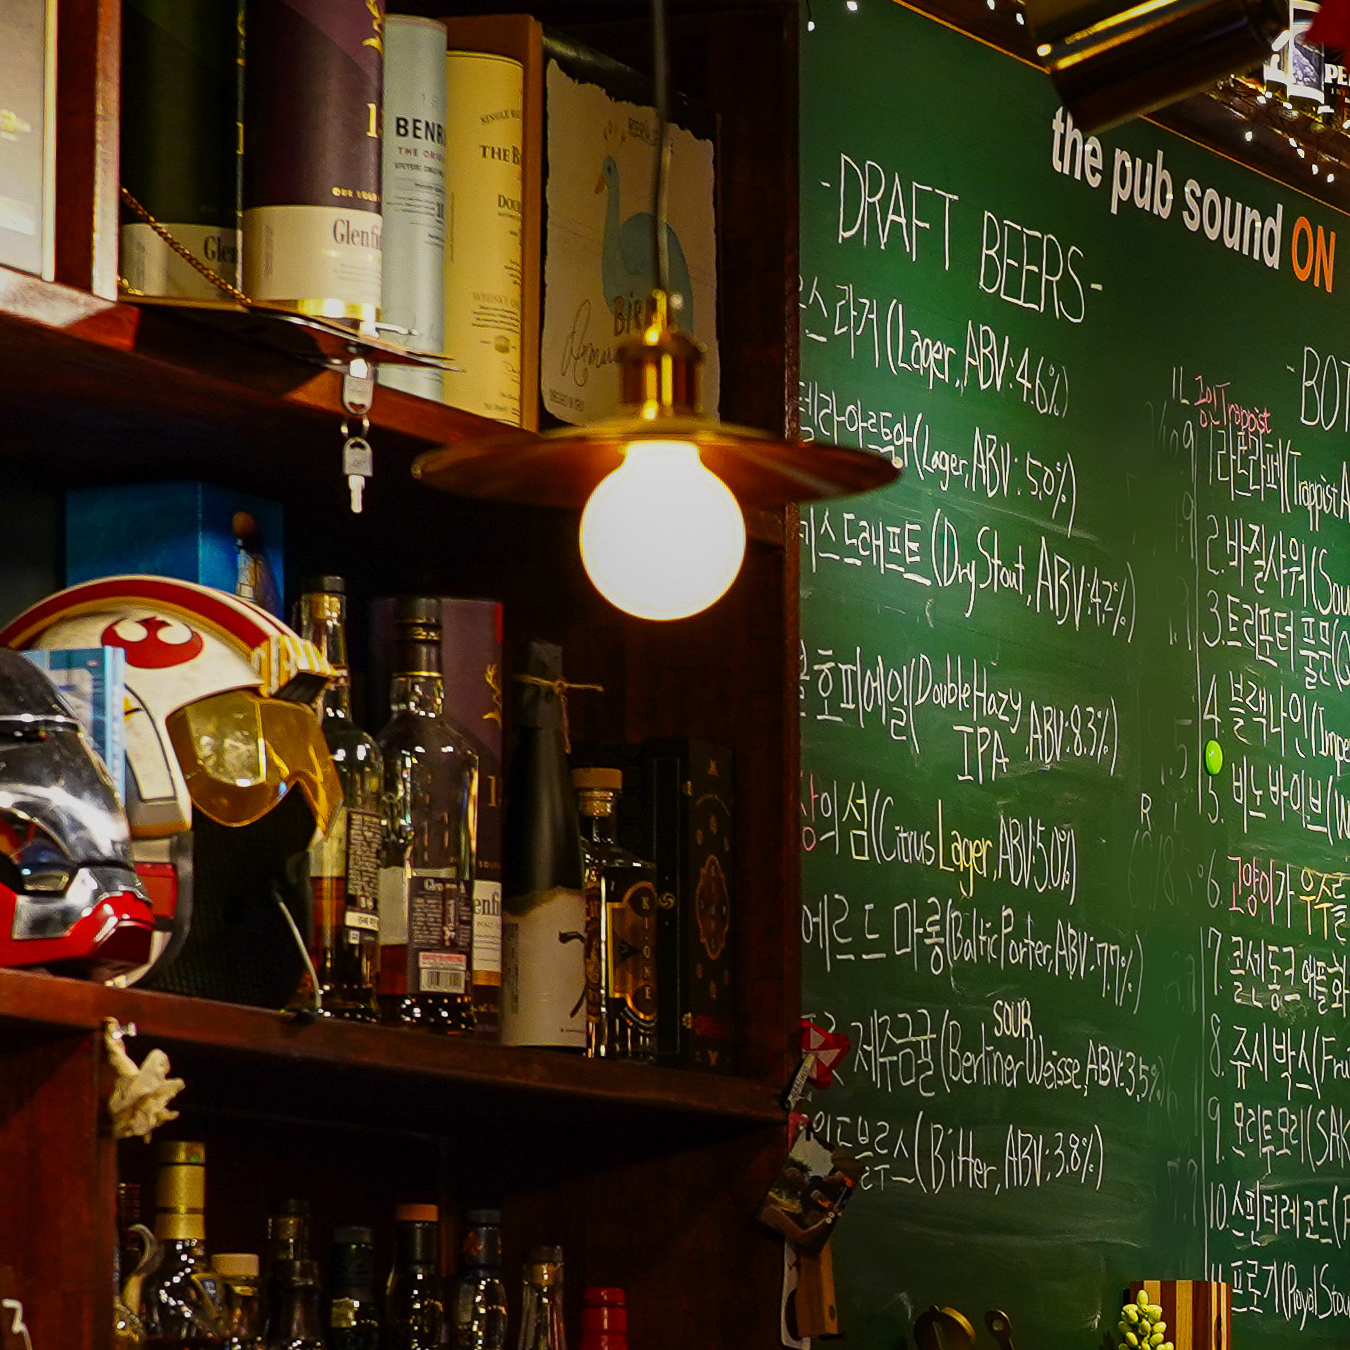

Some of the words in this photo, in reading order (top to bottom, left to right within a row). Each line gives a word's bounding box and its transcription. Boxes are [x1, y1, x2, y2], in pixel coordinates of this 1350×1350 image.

[1051, 106, 1103, 188] the
[1111, 148, 1173, 219] pub
[1182, 179, 1283, 269] sound
[1291, 216, 1336, 293] ON
[953, 724, 1010, 785] IPA
